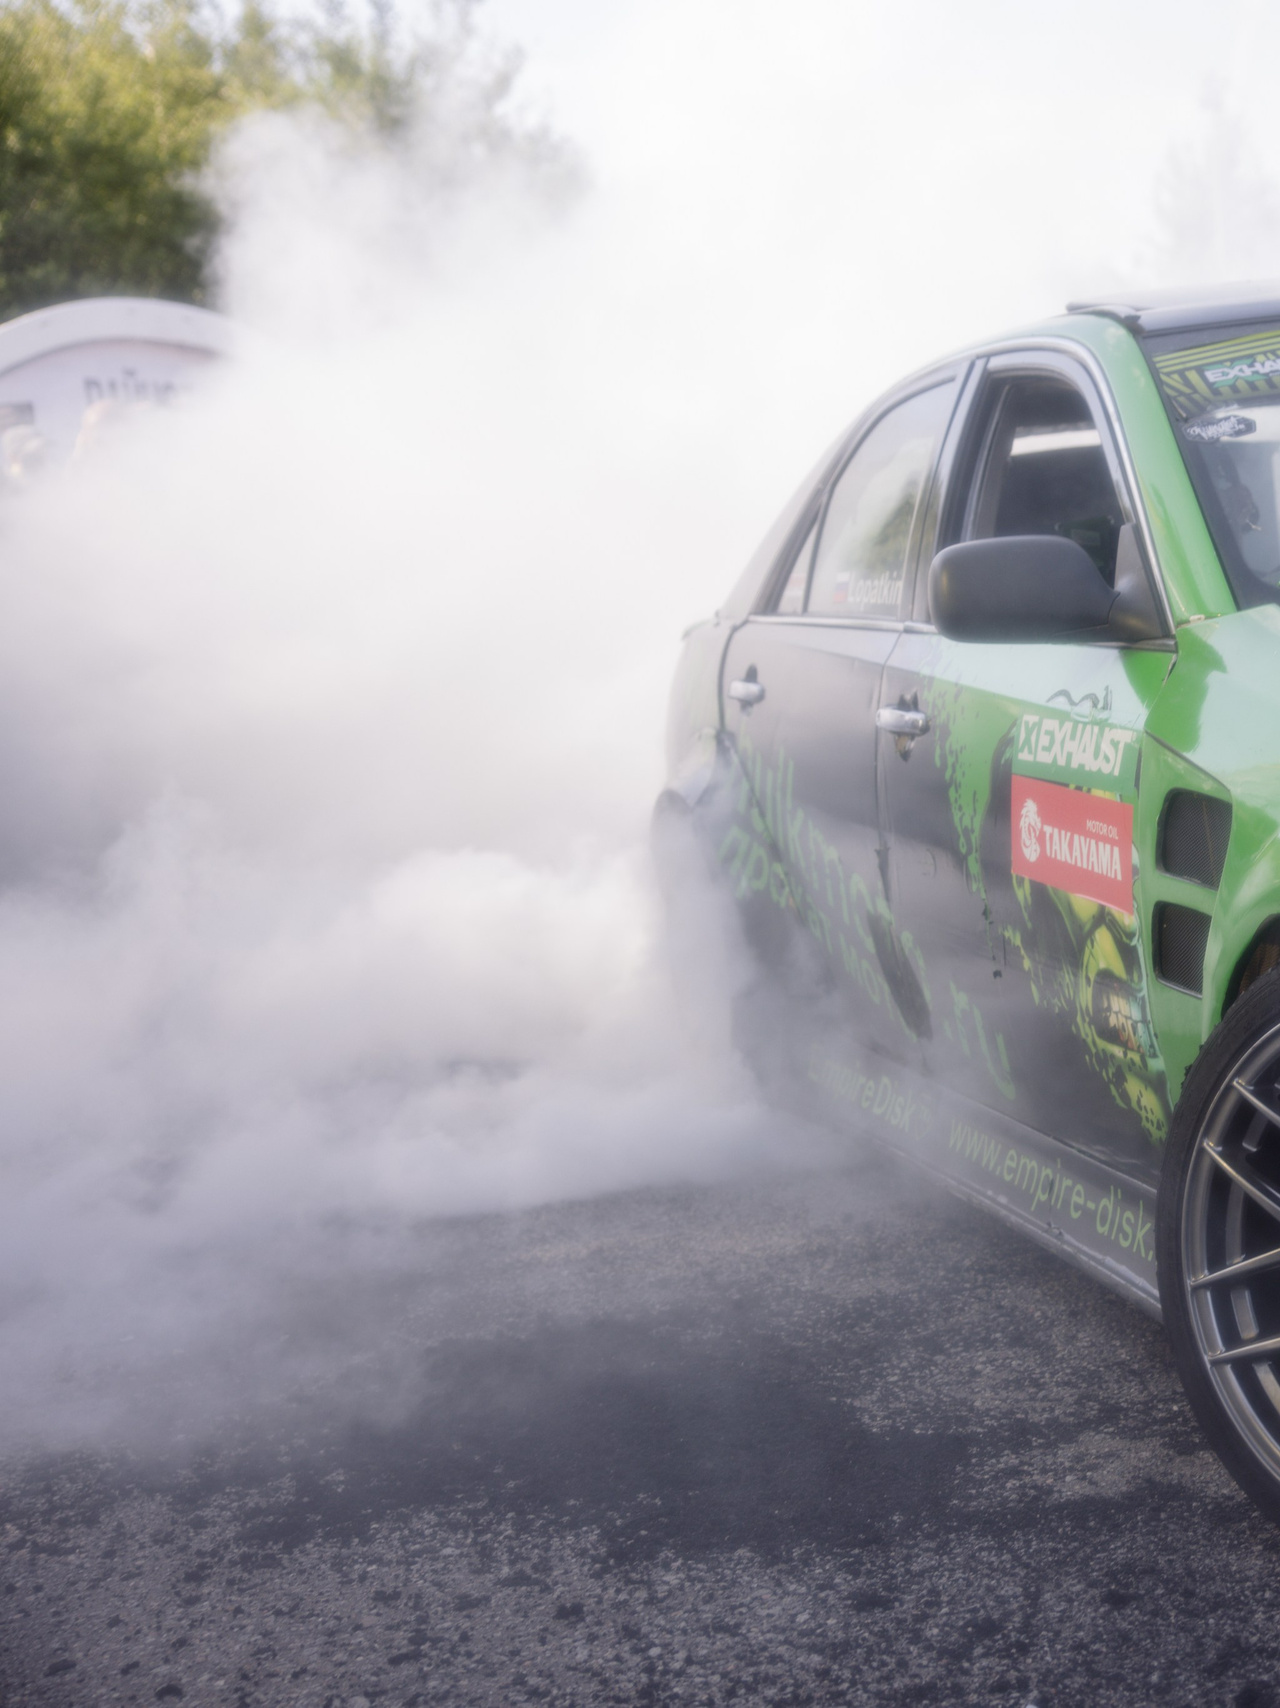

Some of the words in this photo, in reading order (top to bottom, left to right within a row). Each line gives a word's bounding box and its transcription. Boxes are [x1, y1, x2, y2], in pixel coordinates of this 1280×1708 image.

[1036, 719, 1134, 777] EXHAUST
[1043, 825, 1122, 881] TAKAYAMA
[1086, 819, 1108, 835] MOTOR
[1108, 827, 1119, 840] OIL
